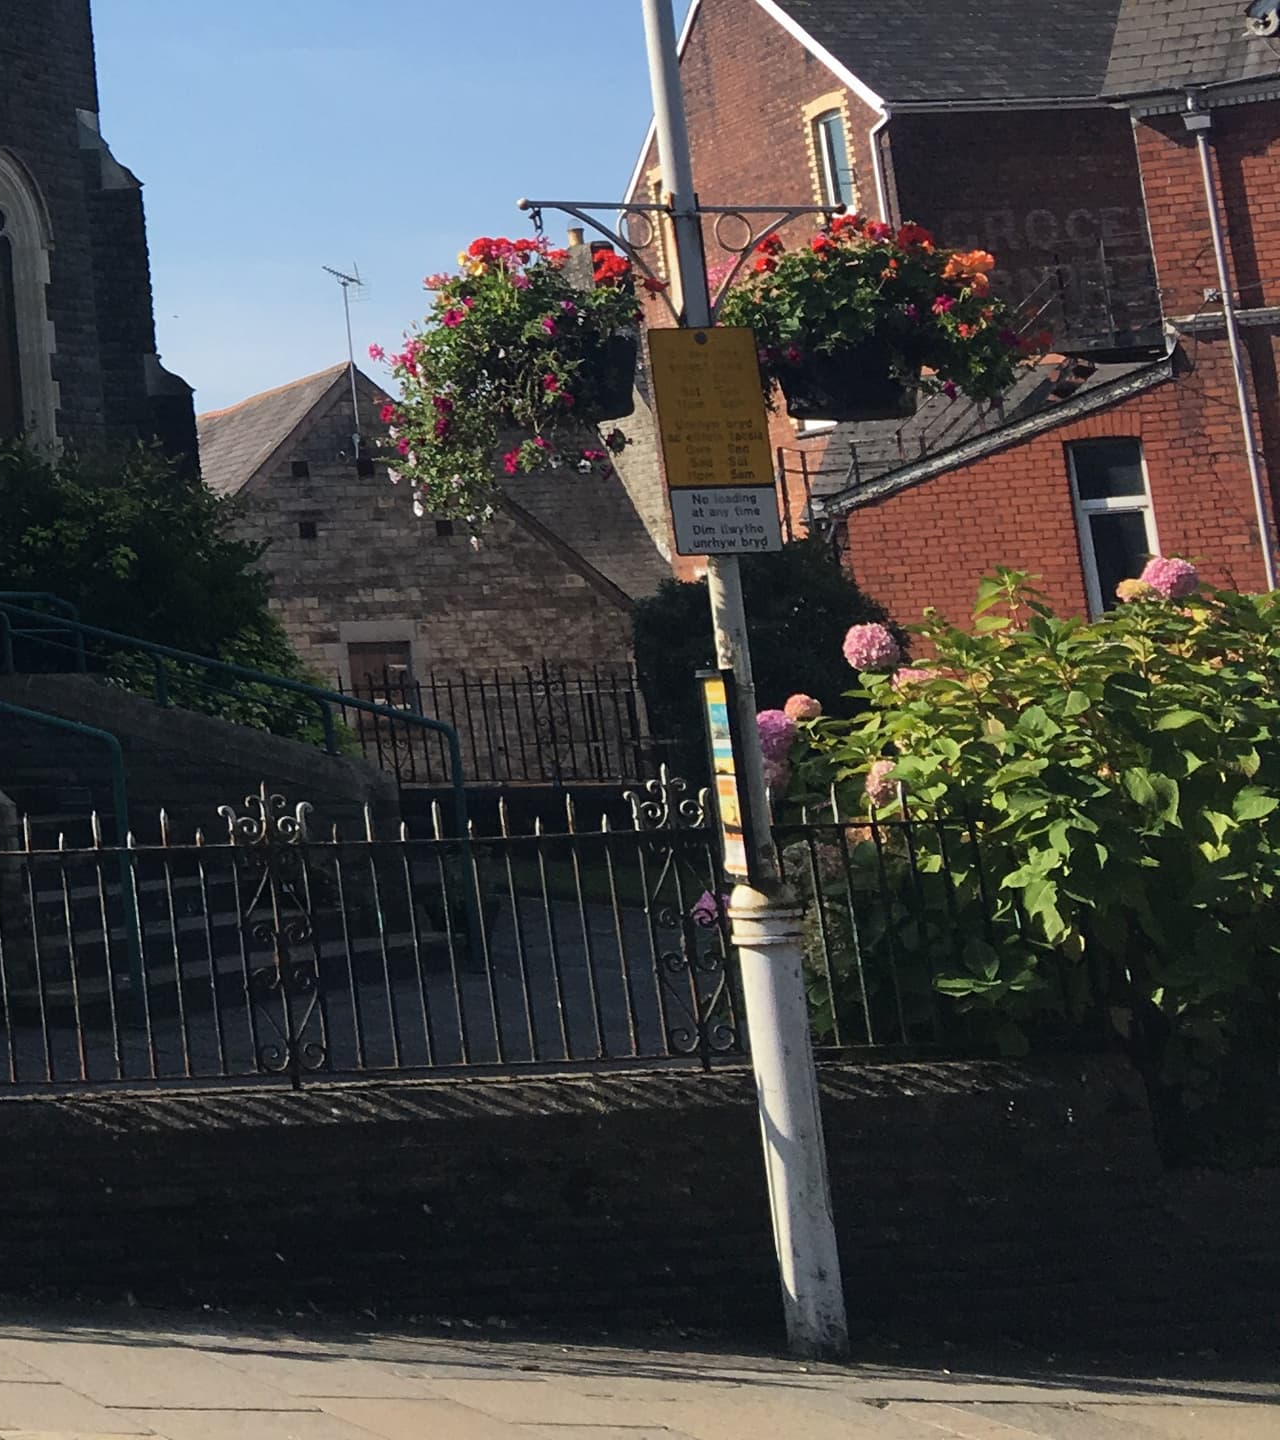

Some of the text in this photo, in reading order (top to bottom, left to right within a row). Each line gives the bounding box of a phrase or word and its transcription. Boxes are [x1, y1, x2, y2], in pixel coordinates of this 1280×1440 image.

[692, 494, 757, 505] No loading
[692, 506, 760, 519] at any time
[692, 523, 764, 536] Dim llwytho
[693, 536, 768, 549] unrhyw bryd
